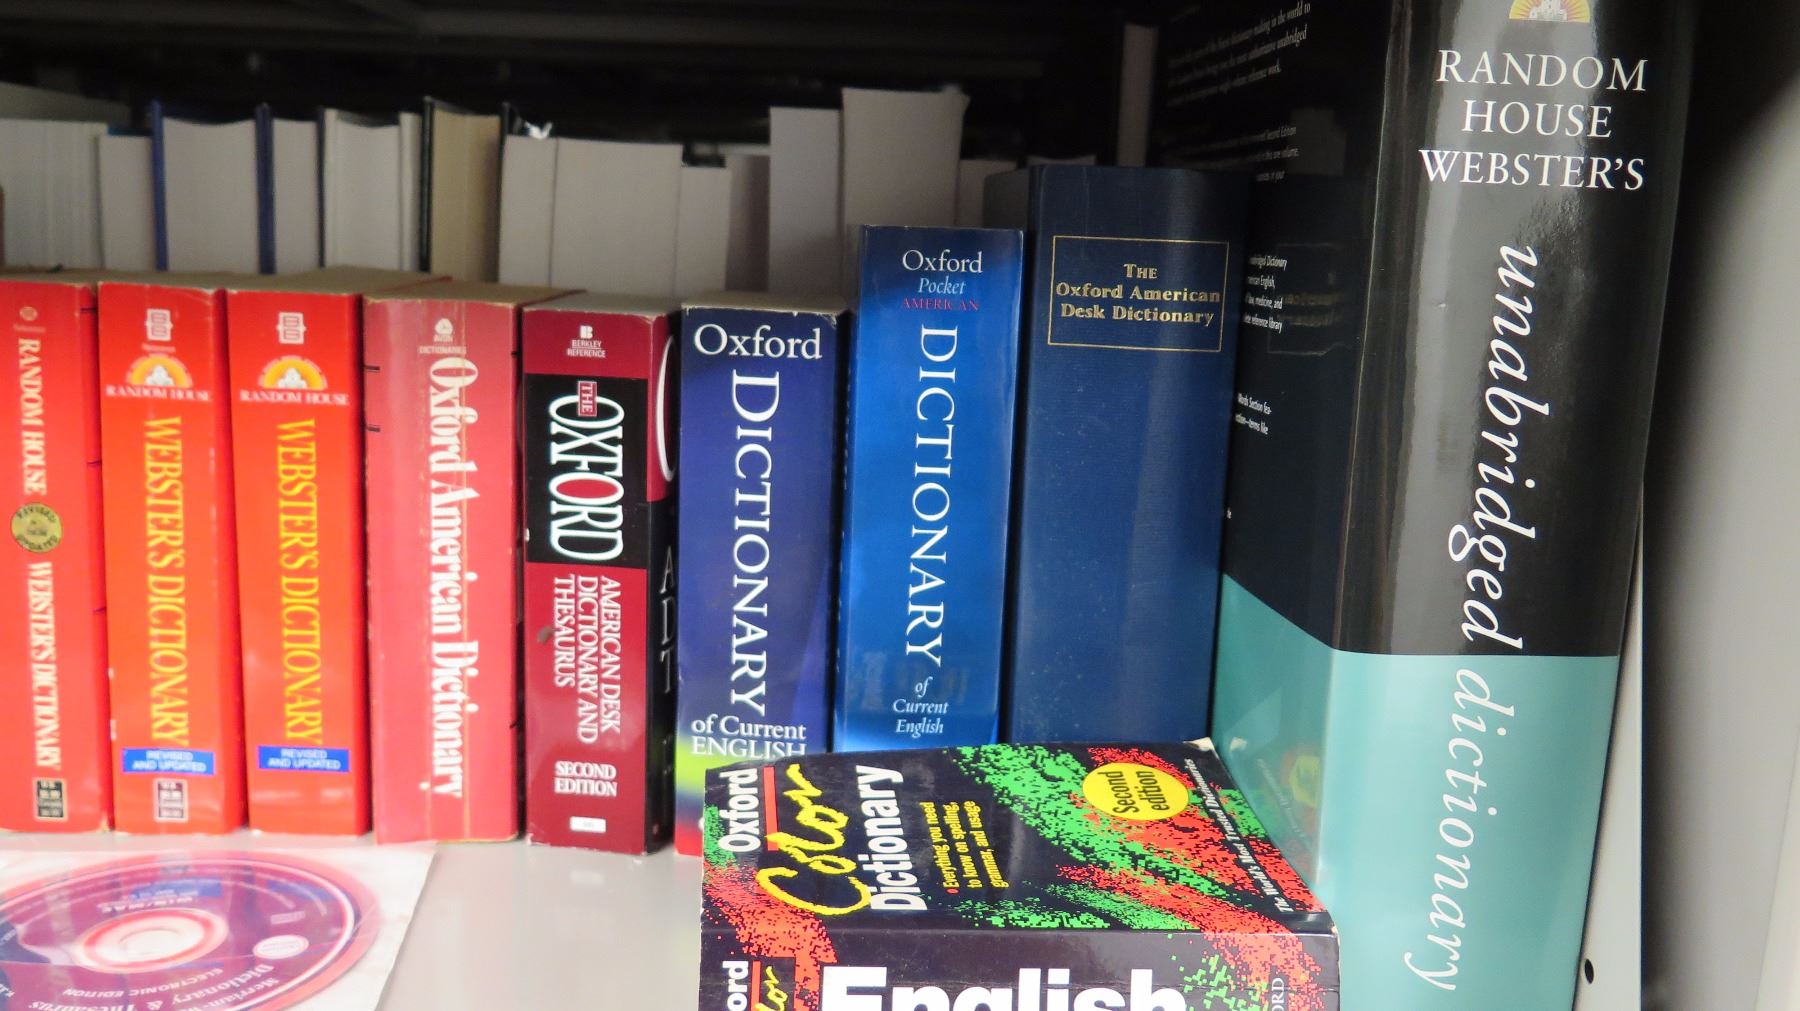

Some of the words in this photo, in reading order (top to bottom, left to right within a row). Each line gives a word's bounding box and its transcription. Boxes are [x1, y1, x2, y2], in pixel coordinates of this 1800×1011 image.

[1304, 3, 1311, 14] to
[1436, 49, 1649, 92] RANDOM
[1461, 99, 1612, 138] HOUSE
[1418, 149, 1646, 191] WEBSTER'S
[901, 249, 983, 274] Oxford
[1123, 264, 1158, 280] THE
[917, 275, 967, 297] Pocket
[1056, 281, 1124, 300] Oxford
[1128, 287, 1221, 303] American
[902, 298, 980, 312] AMERICAN
[1061, 303, 1106, 319] Desk
[1111, 304, 1215, 327] Dictionary
[694, 323, 823, 360] Oxford
[18, 338, 44, 426] RANDOM
[105, 385, 167, 399] RANDOM
[169, 388, 211, 402] HOUSE
[239, 389, 302, 403] RANDOM
[305, 391, 350, 405] HOUSE
[580, 382, 595, 414] THE
[429, 357, 479, 473] Oxford
[22, 430, 47, 496] HOUSE
[1448, 244, 1550, 650] unabridged
[549, 394, 625, 561] OXFORD
[905, 324, 958, 668] DICTIONARY
[429, 478, 480, 635] American
[731, 370, 781, 717] DICTIONARY
[554, 574, 576, 688] THESAURUS
[577, 575, 598, 701] DICTIONARY
[600, 575, 621, 680] AMERICAN
[148, 574, 191, 746] DICTIONARY
[281, 575, 323, 745] DICTIONARY
[915, 676, 933, 698] of
[32, 663, 62, 771] DICTIONARY
[418, 640, 479, 799] Dictionary
[577, 698, 599, 744] AND
[601, 682, 622, 734] DESK
[893, 699, 949, 714] Current
[691, 714, 718, 734] of
[720, 715, 807, 740] Current
[896, 717, 944, 739] English
[146, 750, 193, 761] REVISED
[281, 748, 327, 760] REVISED
[691, 735, 807, 759] ENGLISH
[132, 760, 157, 771] AND
[159, 761, 207, 773] UPDATED
[268, 758, 297, 769] AND
[299, 758, 341, 771] UPDATED
[555, 760, 617, 780] SECOND
[555, 778, 618, 797] EDITION
[1098, 770, 1140, 815] Second
[1135, 770, 1170, 811] edition
[1184, 758, 1219, 808] Dictionaries
[718, 768, 761, 852] Oxford
[920, 802, 939, 825] need
[943, 802, 967, 840] spelling,
[963, 800, 982, 828] usage
[1209, 809, 1240, 841] Trusted
[856, 765, 928, 911] Dictionary
[929, 826, 948, 843] you
[969, 830, 989, 847] and
[1404, 668, 1515, 991] dictionary
[955, 841, 969, 853] on
[1233, 842, 1256, 864] Most
[932, 844, 960, 888] Everything
[960, 854, 979, 877] know
[979, 848, 1010, 888] grammar,
[1248, 866, 1279, 895] World's
[967, 879, 983, 888] to
[1275, 897, 1294, 912] The
[171, 963, 275, 1006] Dictionary
